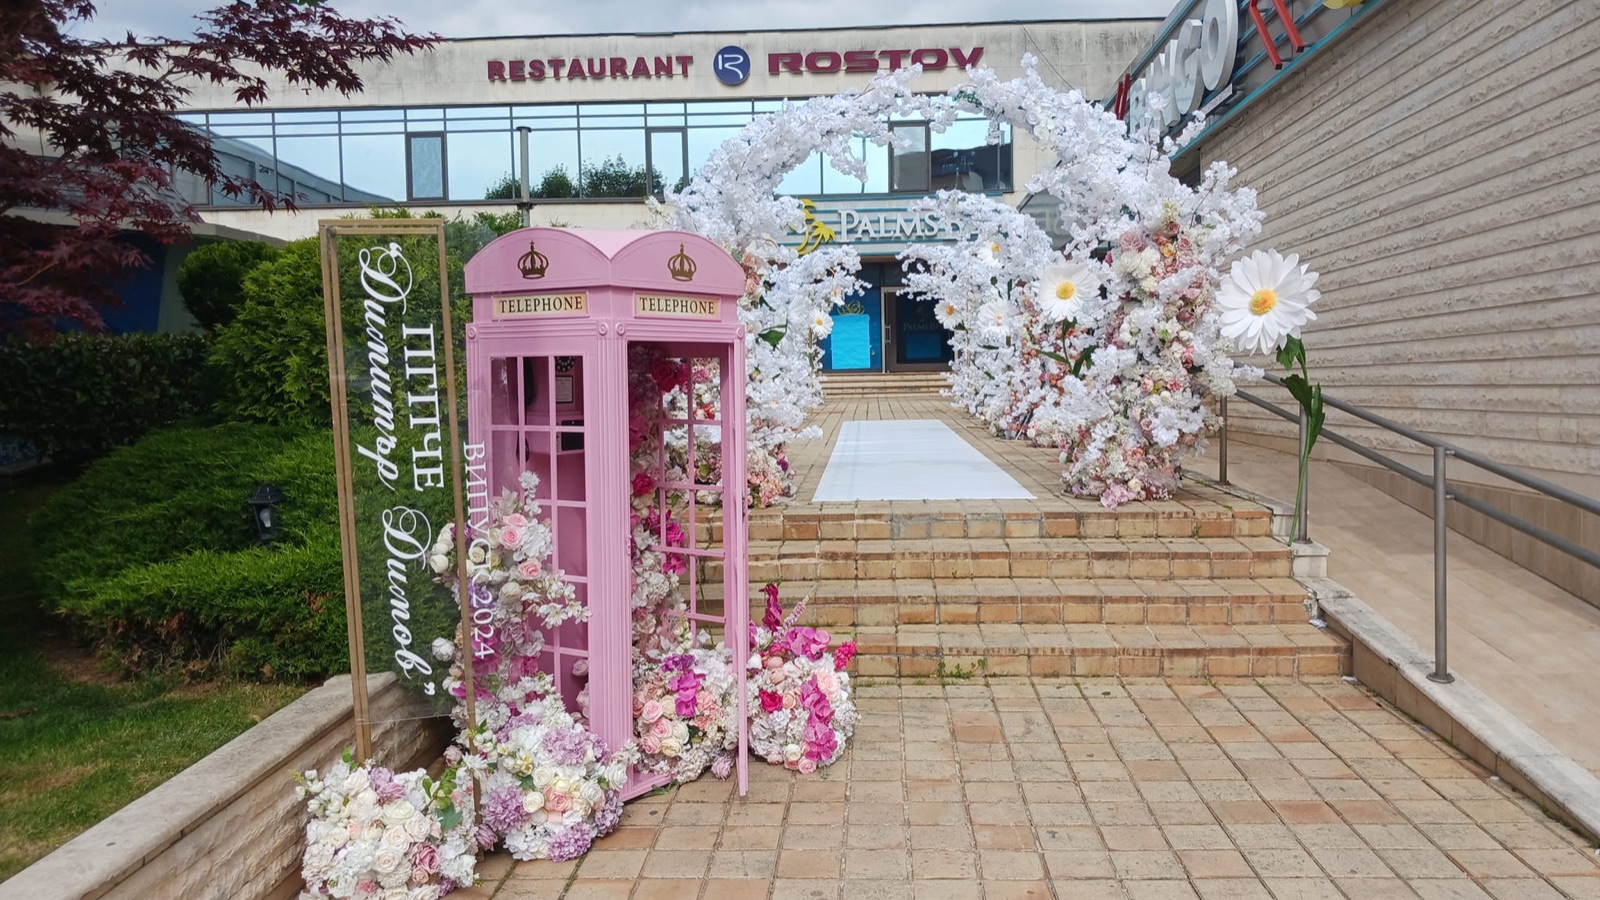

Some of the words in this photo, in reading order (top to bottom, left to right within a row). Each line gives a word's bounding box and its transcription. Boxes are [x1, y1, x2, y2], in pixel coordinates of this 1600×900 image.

[487, 55, 694, 81] RESTAURANT
[767, 46, 985, 75] ROSTOV
[837, 209, 941, 243] PALMS
[499, 296, 583, 314] TELEPHONE
[638, 296, 716, 315] TELEPHONE
[402, 323, 445, 492] ПГПЧЕ
[463, 440, 492, 588] ВИПУСК
[472, 591, 495, 660] 2024
